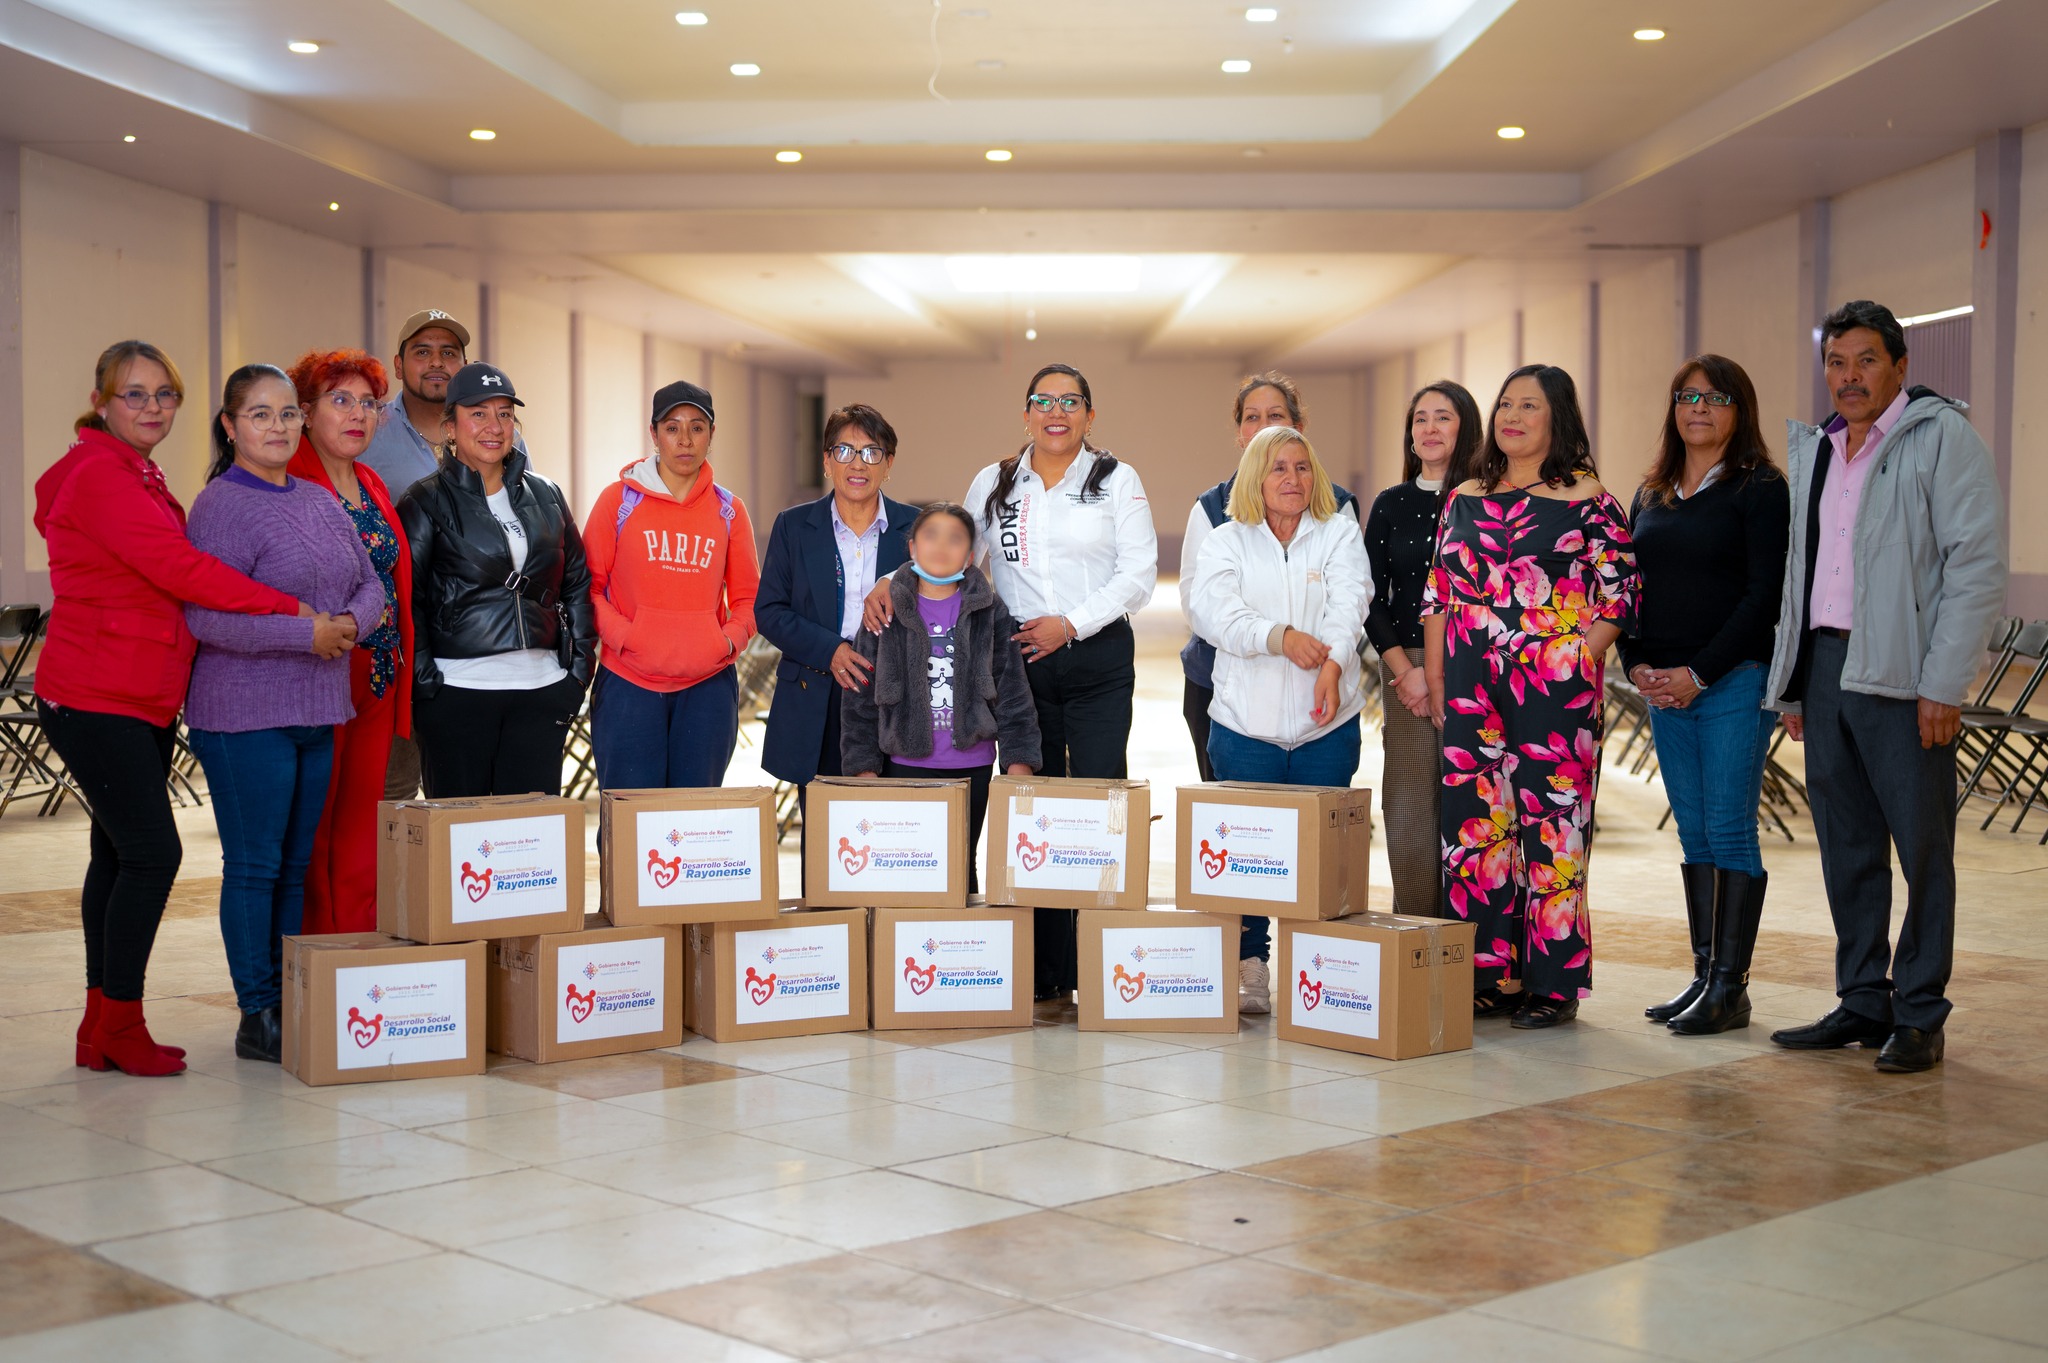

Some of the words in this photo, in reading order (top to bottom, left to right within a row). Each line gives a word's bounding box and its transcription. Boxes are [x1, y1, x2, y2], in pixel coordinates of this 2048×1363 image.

[1000, 500, 1021, 562] EDNA
[643, 530, 716, 568] PARIS
[875, 859, 938, 868] Rayonense
[1052, 855, 1116, 865] Rayonense
[686, 867, 751, 879] Rayonense
[1231, 863, 1288, 875] Rayonense
[493, 872, 529, 881] Desarrollo
[497, 876, 557, 890] Rayonense
[777, 978, 812, 986] Desarrollo
[941, 977, 1003, 987] Rayonense
[780, 982, 840, 995] Rayonense
[1150, 984, 1213, 994] Rayonense
[1322, 989, 1350, 998] Desarrollo
[596, 994, 630, 1002] Desarrollo
[1325, 996, 1372, 1011] Rayonense
[599, 998, 655, 1011] Rayonense
[384, 1018, 424, 1027] Desarrollo
[427, 1015, 450, 1023] Social
[388, 1022, 456, 1037] Rayonense
